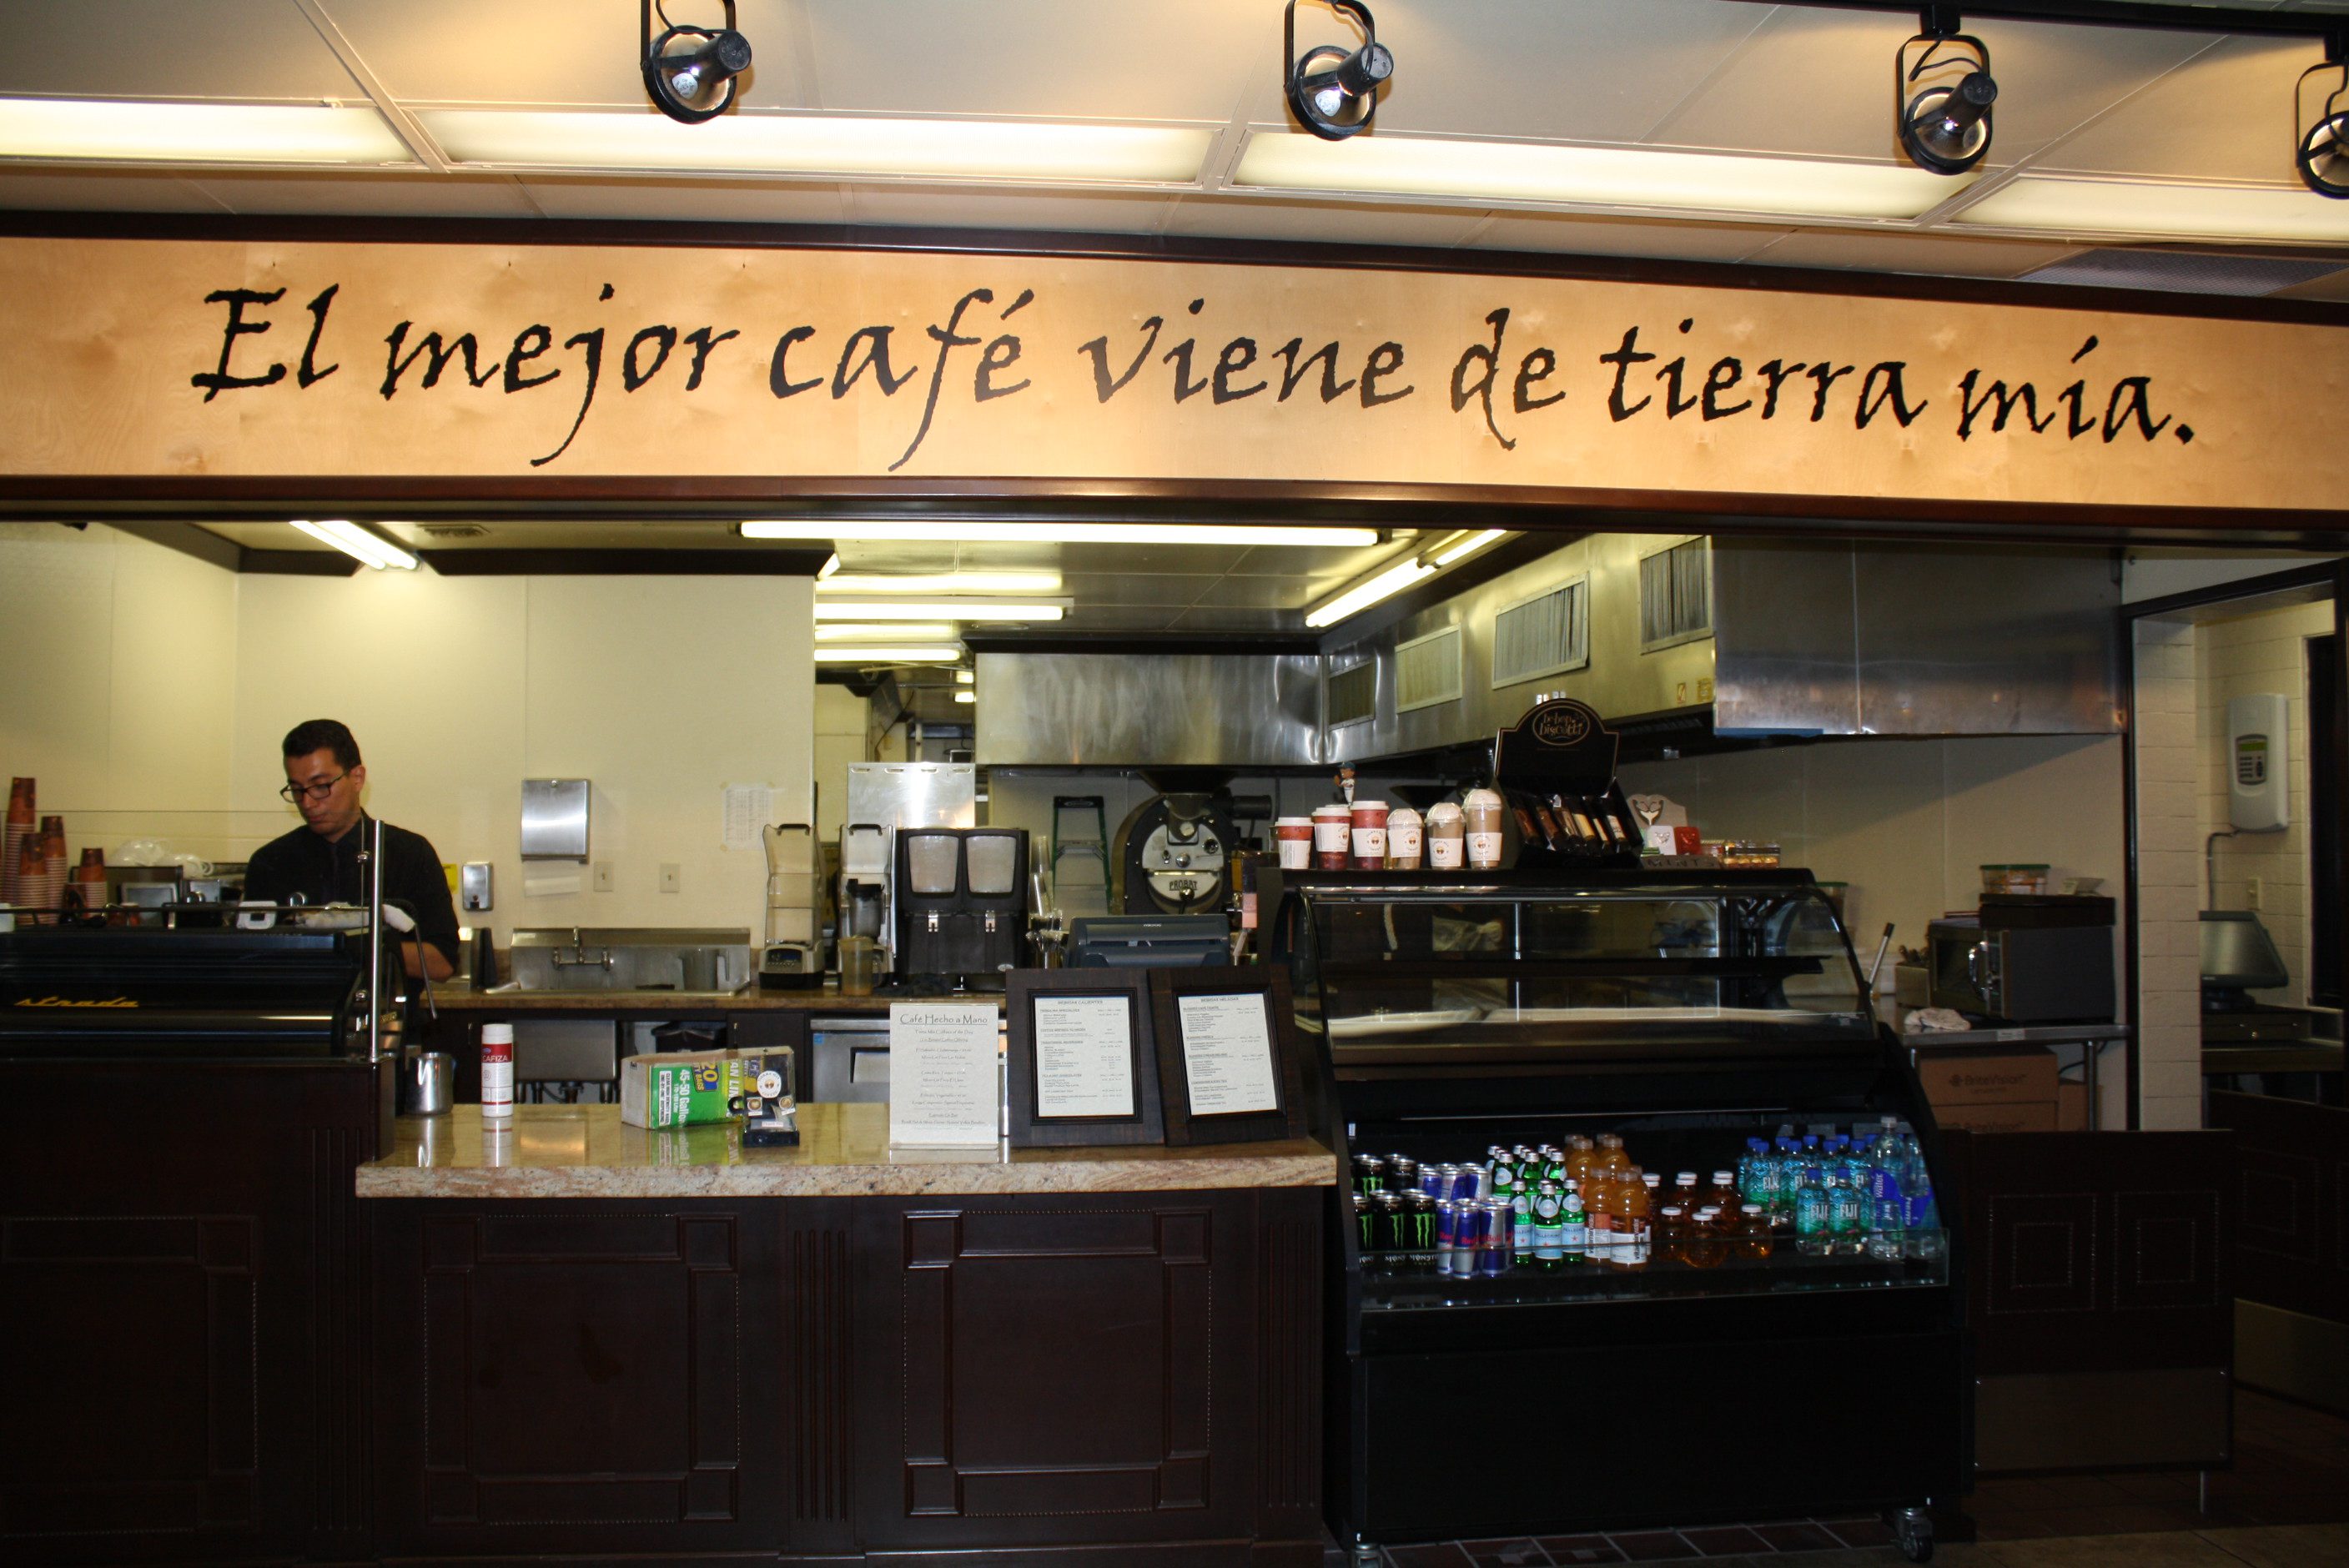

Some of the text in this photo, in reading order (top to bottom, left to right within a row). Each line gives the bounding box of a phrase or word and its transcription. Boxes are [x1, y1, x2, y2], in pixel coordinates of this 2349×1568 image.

[191, 284, 2195, 473] El mejor café viene de tierra mía.
[1169, 879, 1198, 891] PROBAT
[900, 1013, 923, 1024] Café
[925, 1013, 953, 1024] Hecho
[963, 1013, 988, 1024] Mano
[679, 1069, 690, 1096] 45-50
[1810, 1204, 1828, 1219] FIJI
[1839, 1204, 1858, 1219] FIJI
